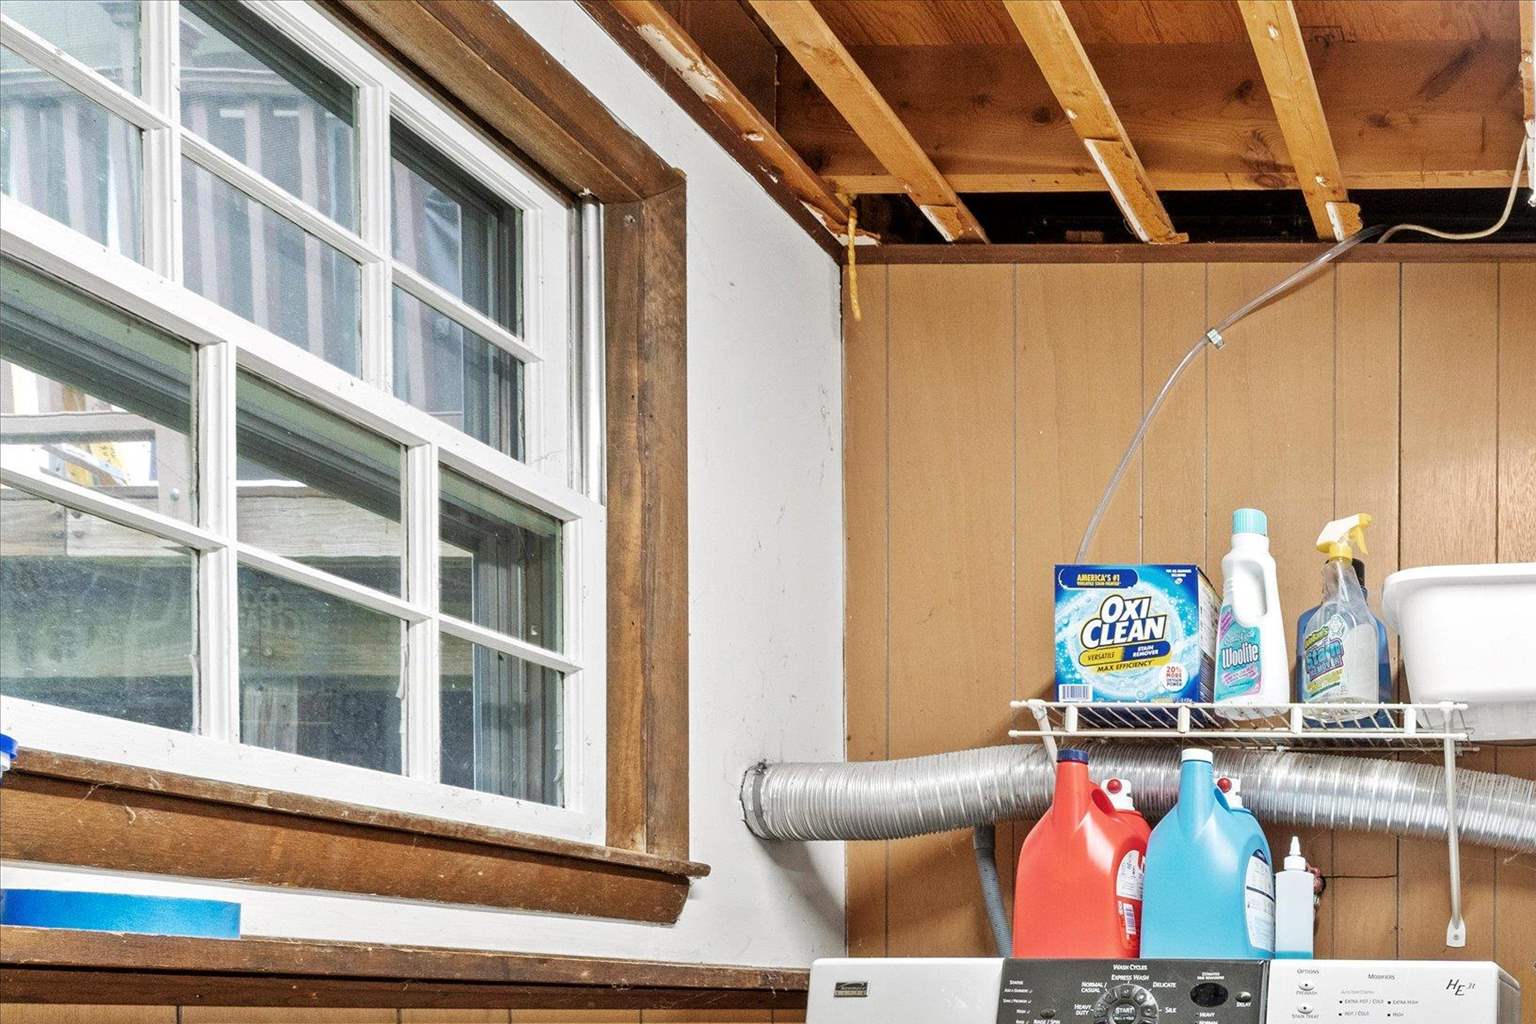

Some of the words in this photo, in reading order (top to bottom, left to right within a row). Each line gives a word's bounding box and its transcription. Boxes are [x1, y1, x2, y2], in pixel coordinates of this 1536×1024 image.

[1077, 574, 1111, 582] AMERICA'S
[1100, 595, 1151, 624] OXI
[1081, 615, 1167, 649] CLEAN
[1087, 651, 1116, 661] VERSATILE
[1132, 649, 1159, 658] REMOVER
[1222, 643, 1259, 669] Woolite
[1097, 665, 1113, 673] MAX
[1116, 660, 1153, 671] EFFICIENCY
